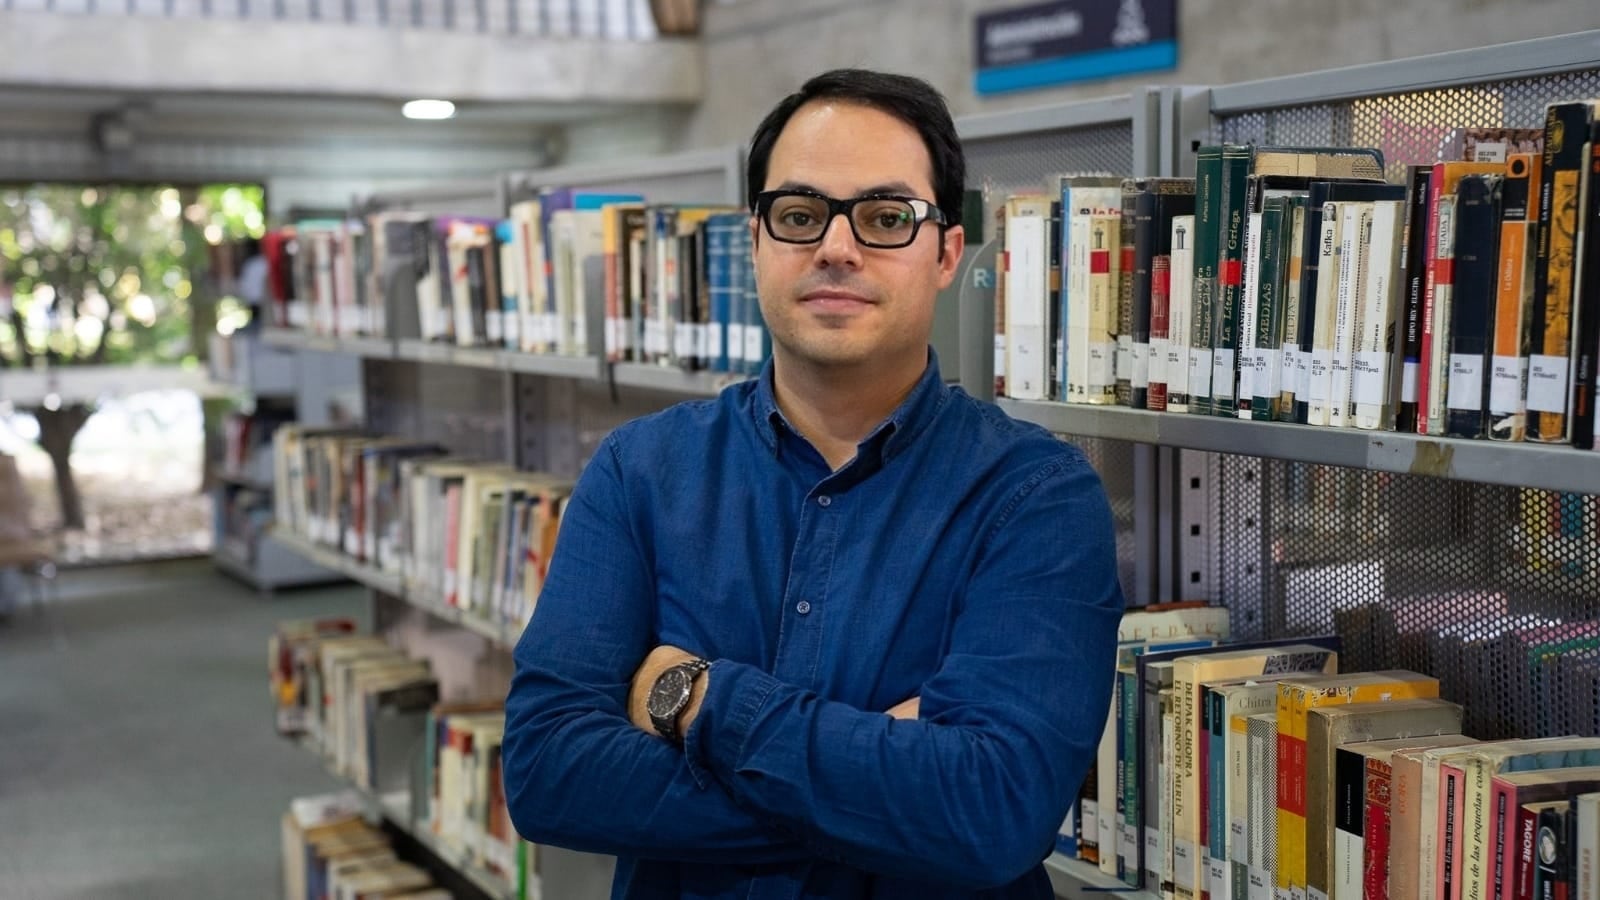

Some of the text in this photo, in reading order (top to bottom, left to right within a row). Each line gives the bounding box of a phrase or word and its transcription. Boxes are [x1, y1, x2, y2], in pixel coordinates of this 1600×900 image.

[1321, 229, 1334, 257] Kafka
[1439, 219, 1448, 259] ESTIADA
[1221, 208, 1241, 342] La Literaa Griega
[1174, 679, 1182, 693] EL
[1239, 696, 1274, 710] Chitra
[1184, 682, 1193, 778] DEEPAK CHOPRA
[1175, 754, 1182, 770] DE
[1475, 758, 1484, 790] cosas
[1175, 774, 1184, 817] MERLÍN
[1473, 792, 1482, 845] pequeñas
[1471, 845, 1480, 862] las
[1522, 819, 1534, 863] TAGORE
[1470, 863, 1479, 878] de
